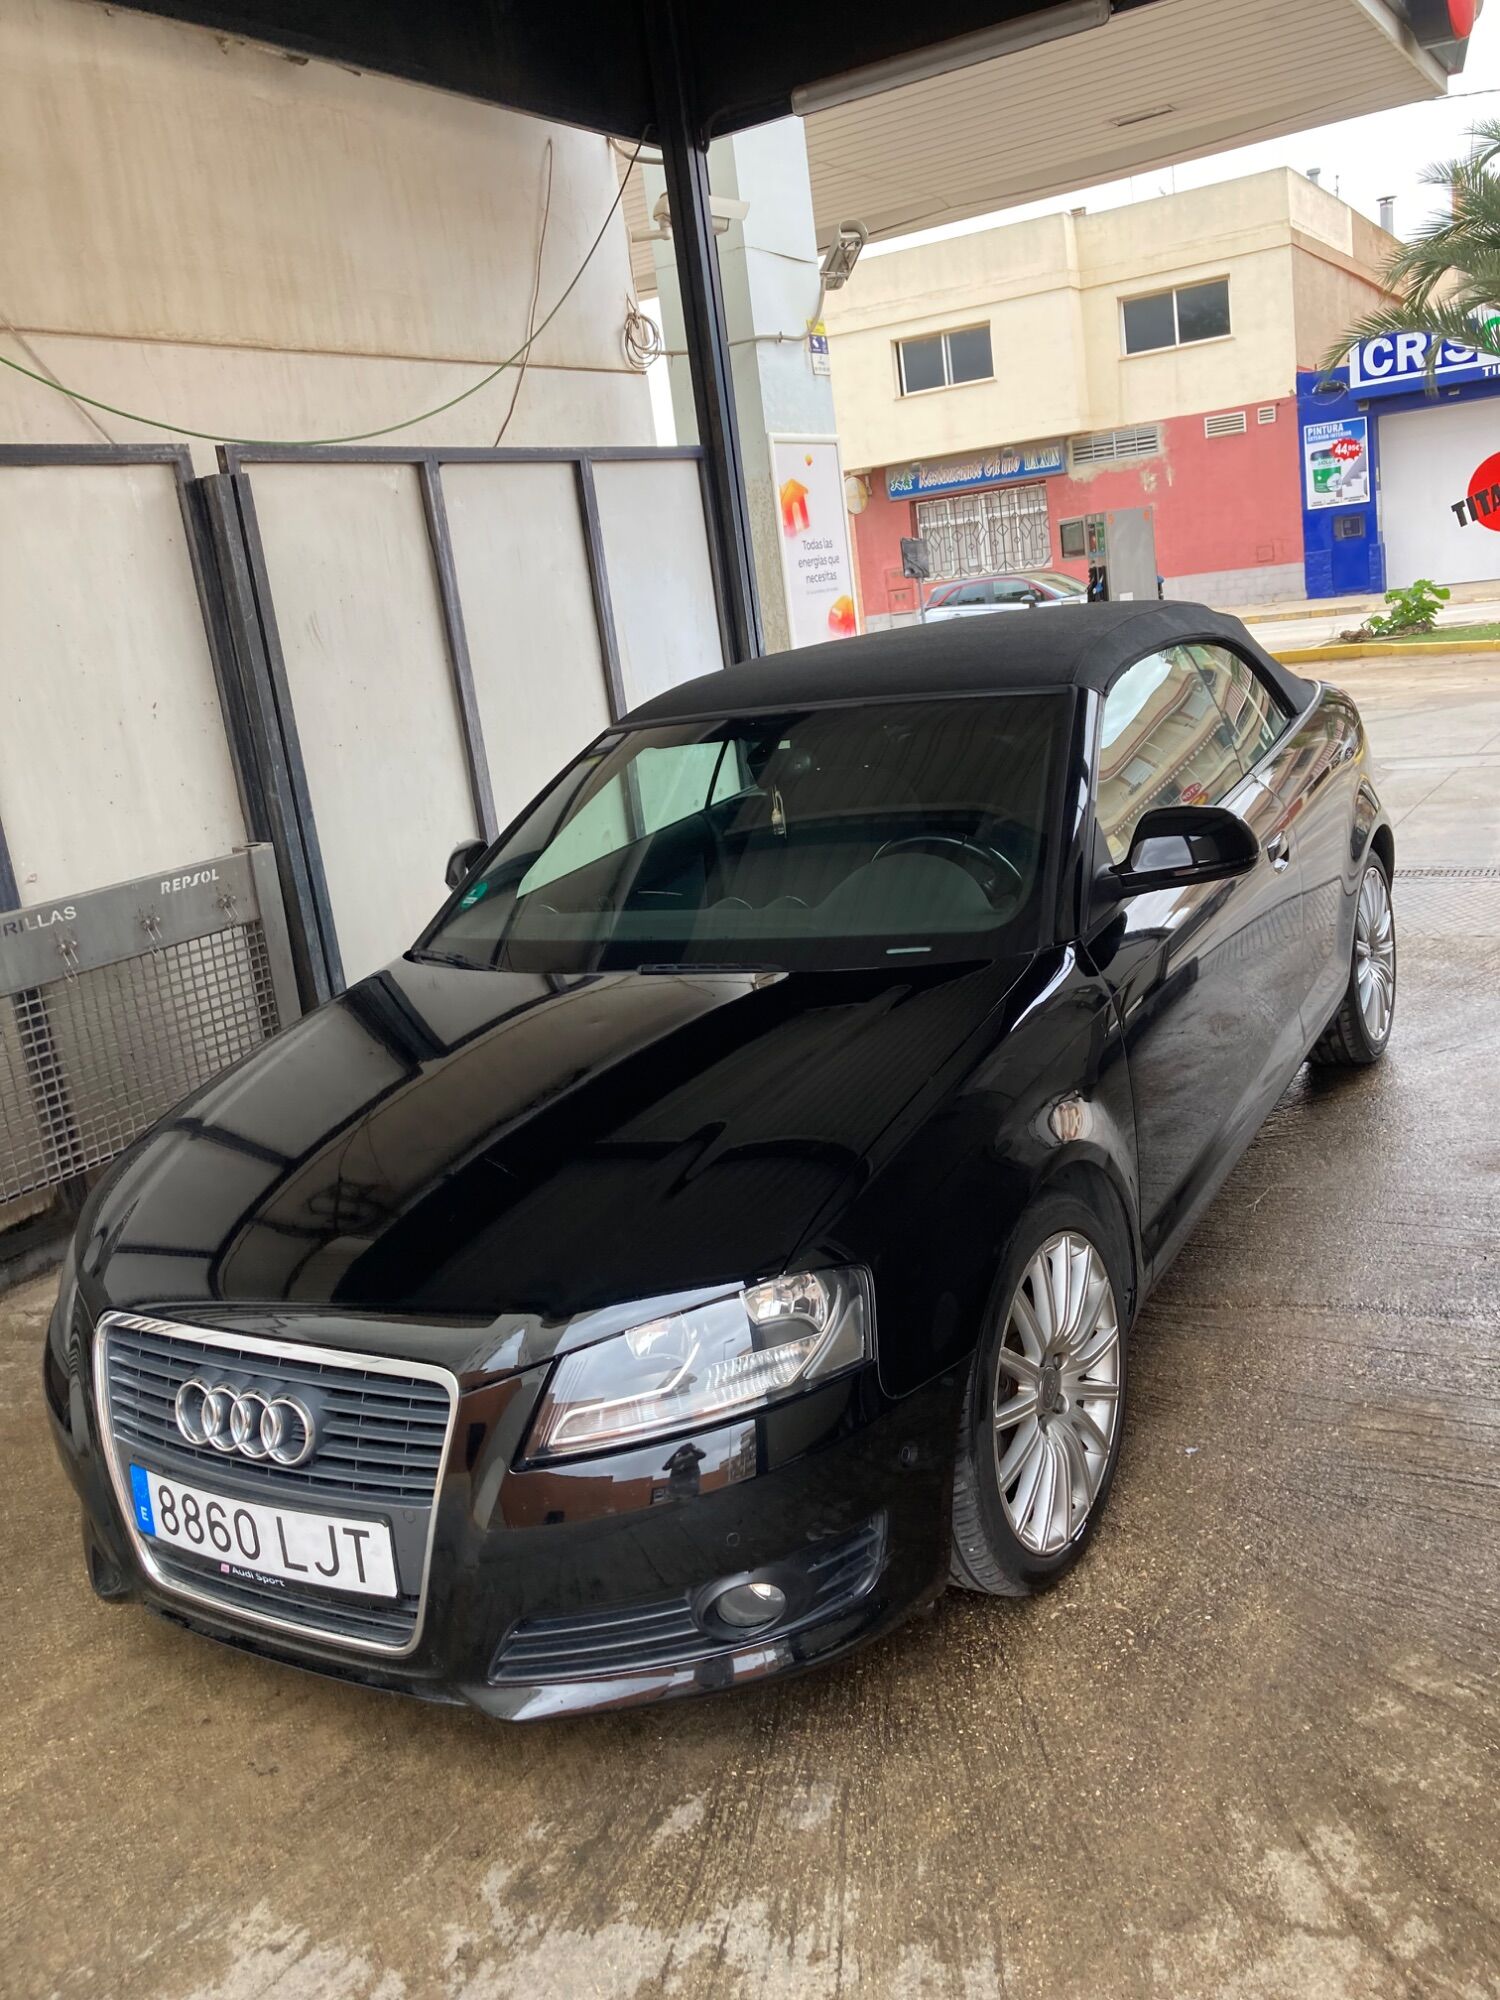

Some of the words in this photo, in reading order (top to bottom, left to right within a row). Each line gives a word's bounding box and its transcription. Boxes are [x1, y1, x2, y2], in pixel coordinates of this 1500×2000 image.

[1308, 422, 1344, 437] PINTURA
[801, 539, 824, 550] Todas
[823, 536, 833, 549] las
[828, 555, 840, 567] que
[805, 571, 838, 584] necesitas
[160, 869, 220, 895] REPSOL
[140, 1506, 149, 1521] E
[158, 1484, 261, 1561] 8860
[275, 1515, 370, 1583] LJT
[231, 1566, 255, 1580] Audi
[255, 1572, 286, 1588] Sport
